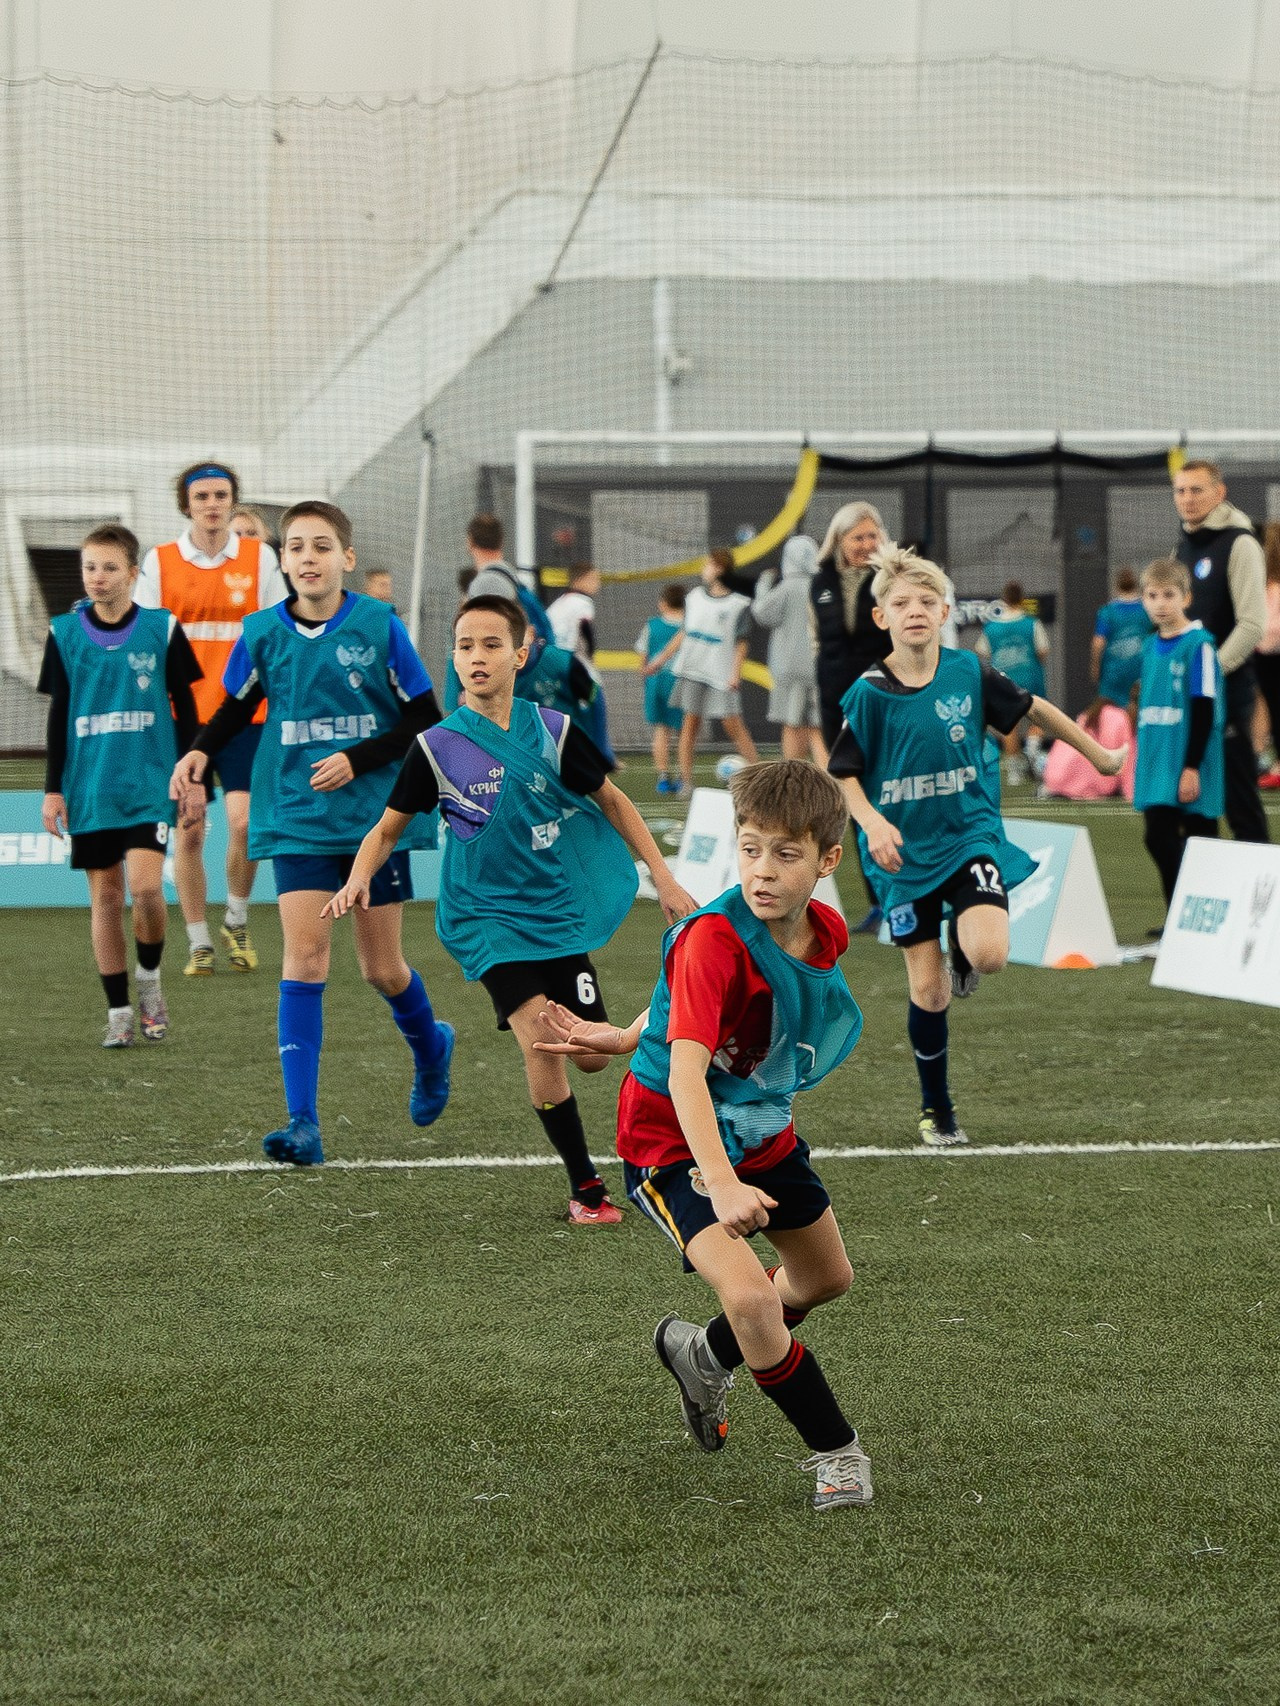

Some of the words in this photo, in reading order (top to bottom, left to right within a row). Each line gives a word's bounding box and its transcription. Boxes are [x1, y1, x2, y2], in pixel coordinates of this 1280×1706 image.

[489, 766, 505, 779] Ф
[156, 821, 168, 844] 8
[970, 863, 1003, 892] 12
[577, 972, 596, 1004] 6
